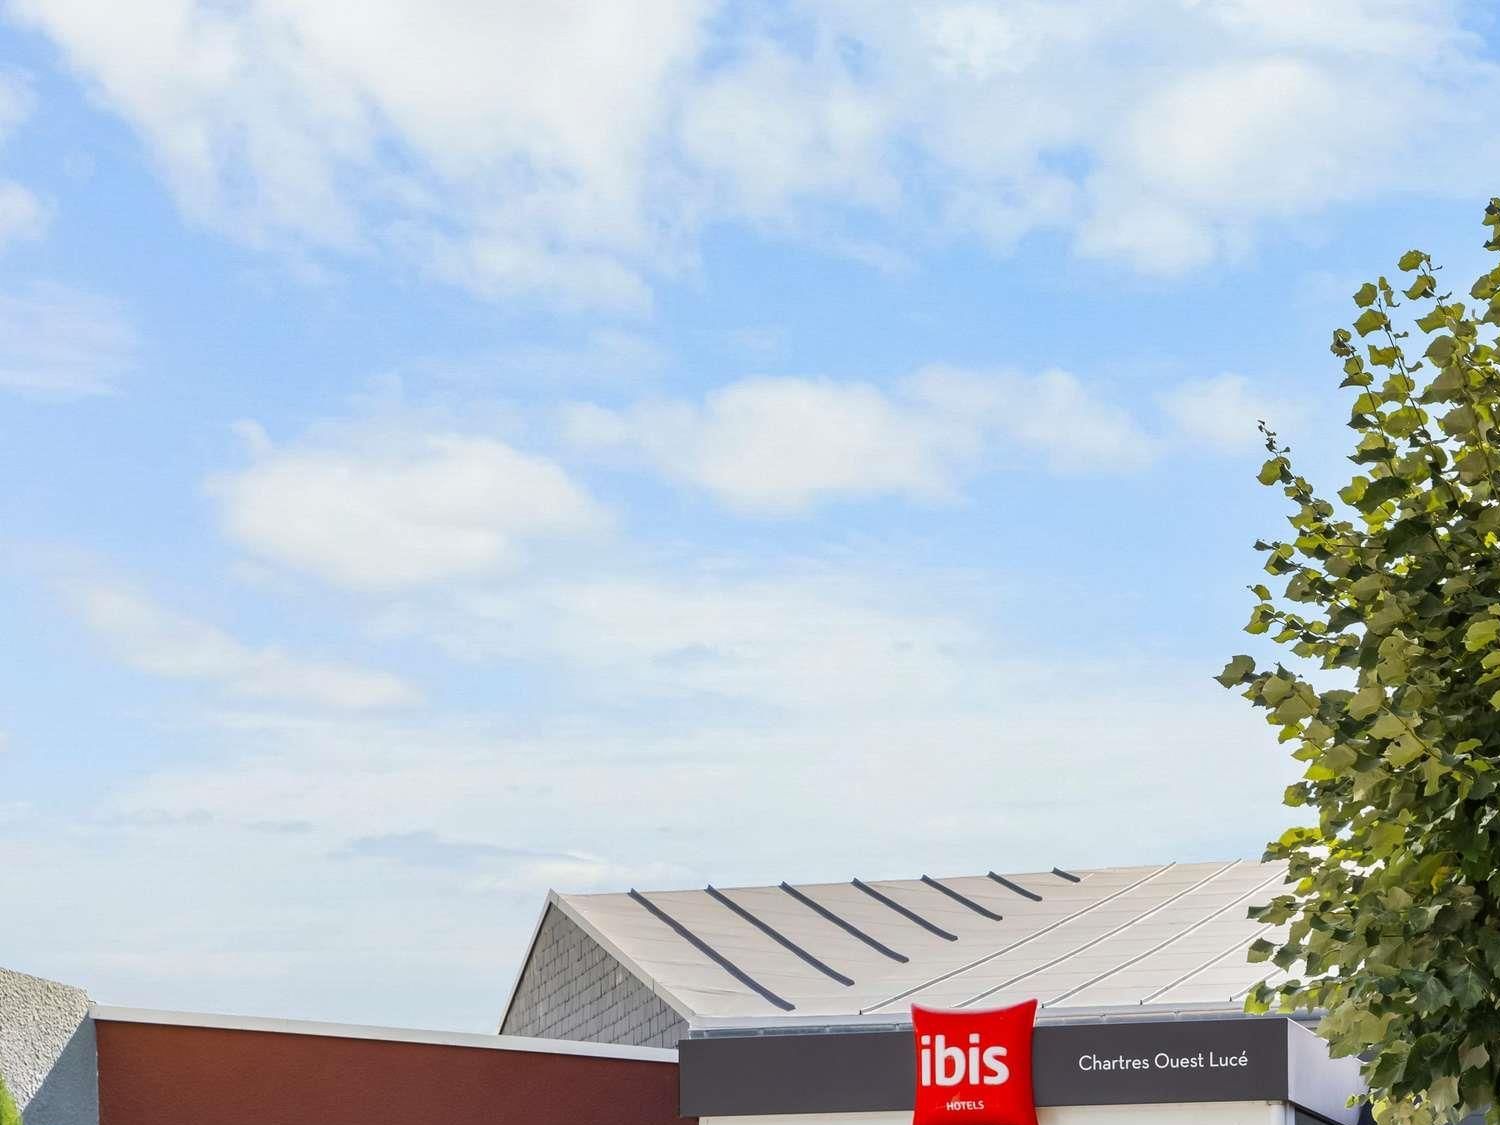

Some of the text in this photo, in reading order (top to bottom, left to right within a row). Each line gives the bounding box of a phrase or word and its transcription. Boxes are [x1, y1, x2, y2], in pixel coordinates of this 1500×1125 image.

[921, 1033, 1010, 1087] ibis
[1078, 1050, 1249, 1070] Chartres Ouest Lucé
[946, 1100, 985, 1111] HOTELS
